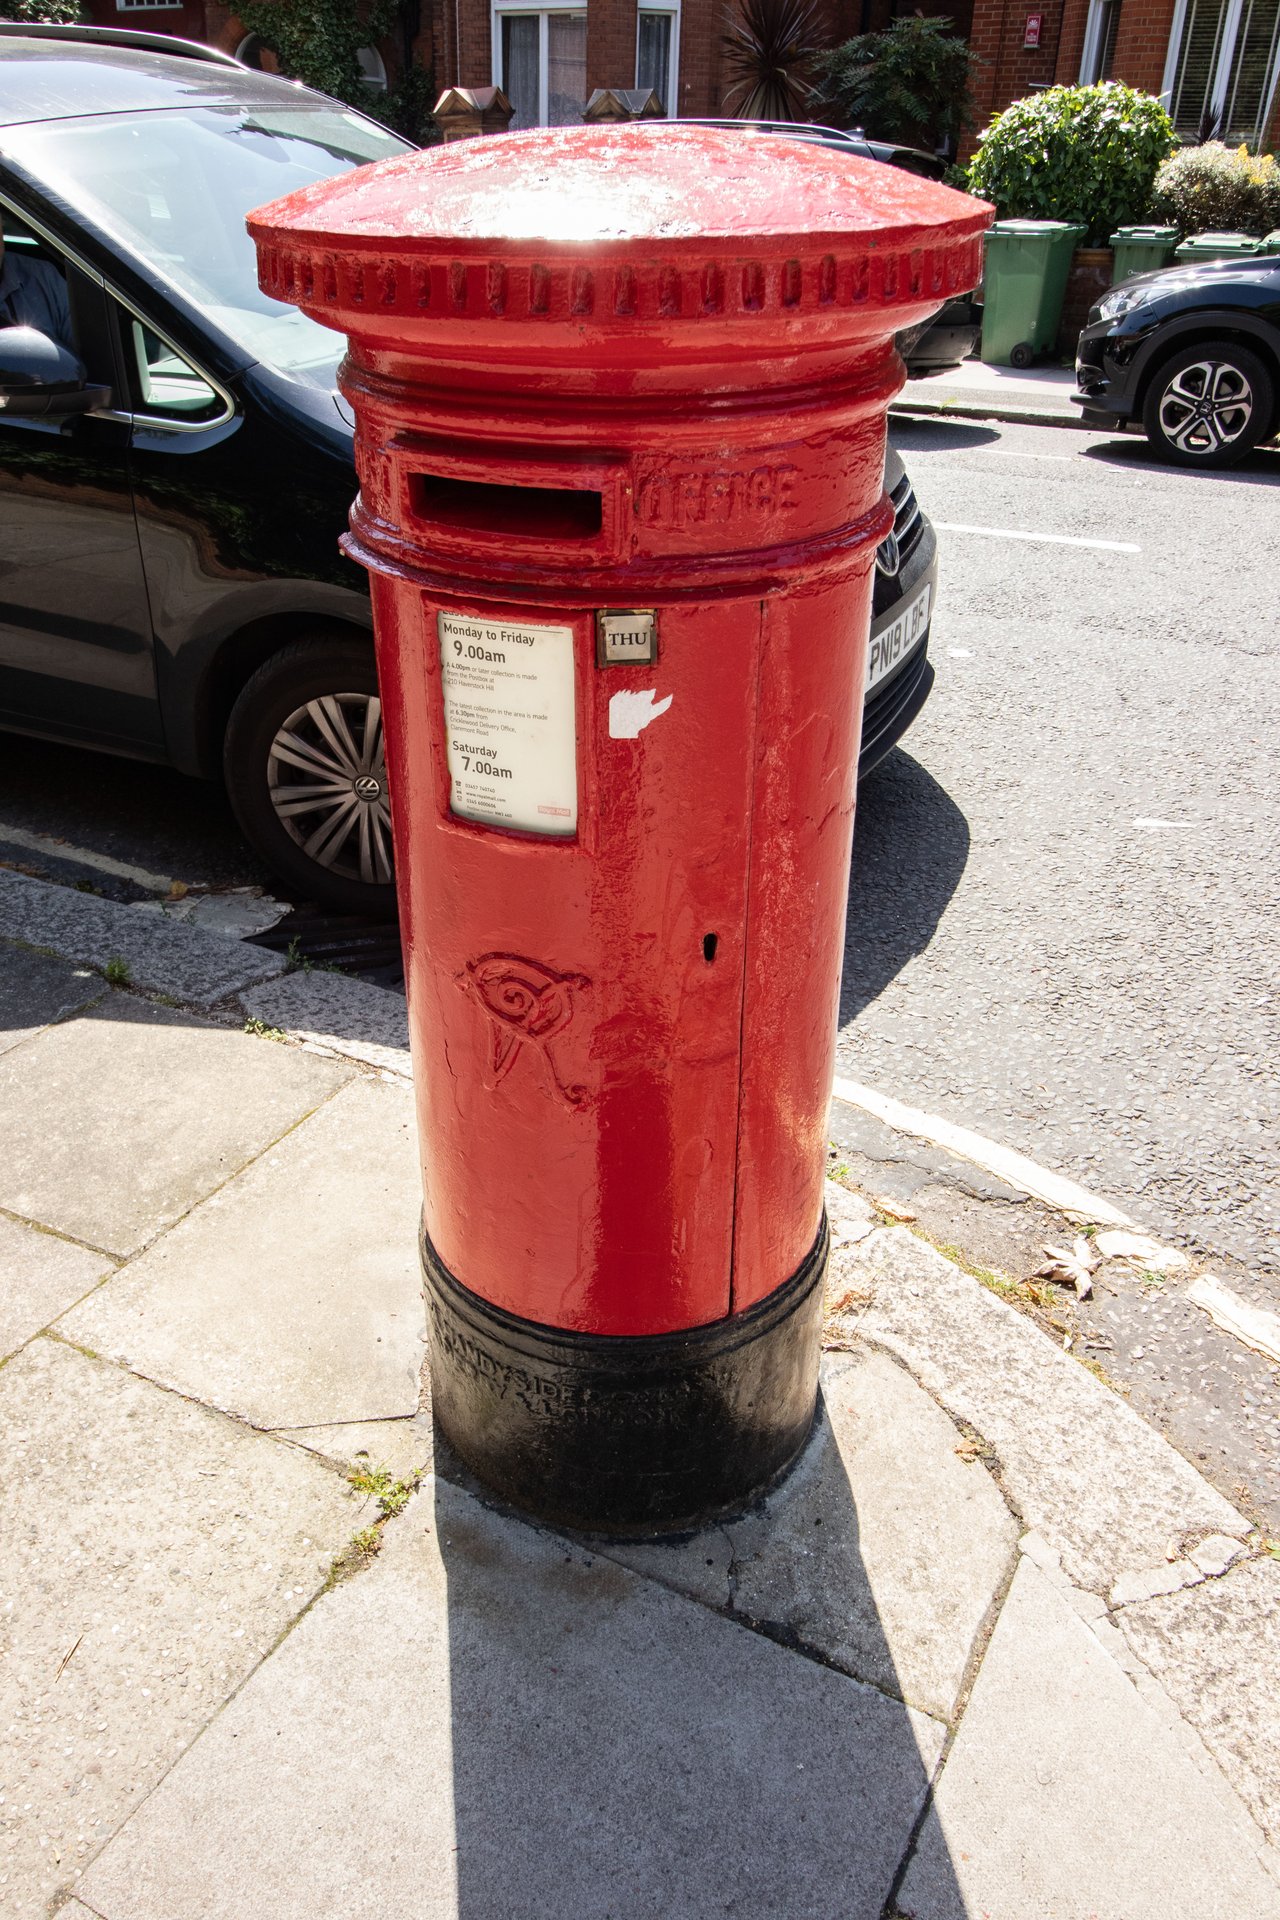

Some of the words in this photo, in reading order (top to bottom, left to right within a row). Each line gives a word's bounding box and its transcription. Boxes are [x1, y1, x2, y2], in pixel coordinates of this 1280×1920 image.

[443, 622, 483, 641] Monday
[486, 630, 497, 641] to
[501, 630, 535, 647] Friday
[608, 632, 648, 646] THU
[453, 640, 506, 663] 9.00am
[446, 669, 459, 677] from
[459, 671, 468, 679] the
[490, 669, 516, 678] collection
[521, 673, 538, 681] made
[458, 680, 485, 690] Haverstock
[449, 699, 459, 707] The
[459, 702, 473, 710] latest
[473, 705, 497, 714] collection
[503, 709, 513, 717] the
[475, 713, 489, 721] from
[479, 721, 500, 731] Delivery
[452, 740, 498, 759] Saturday
[461, 756, 513, 779] 7.00am
